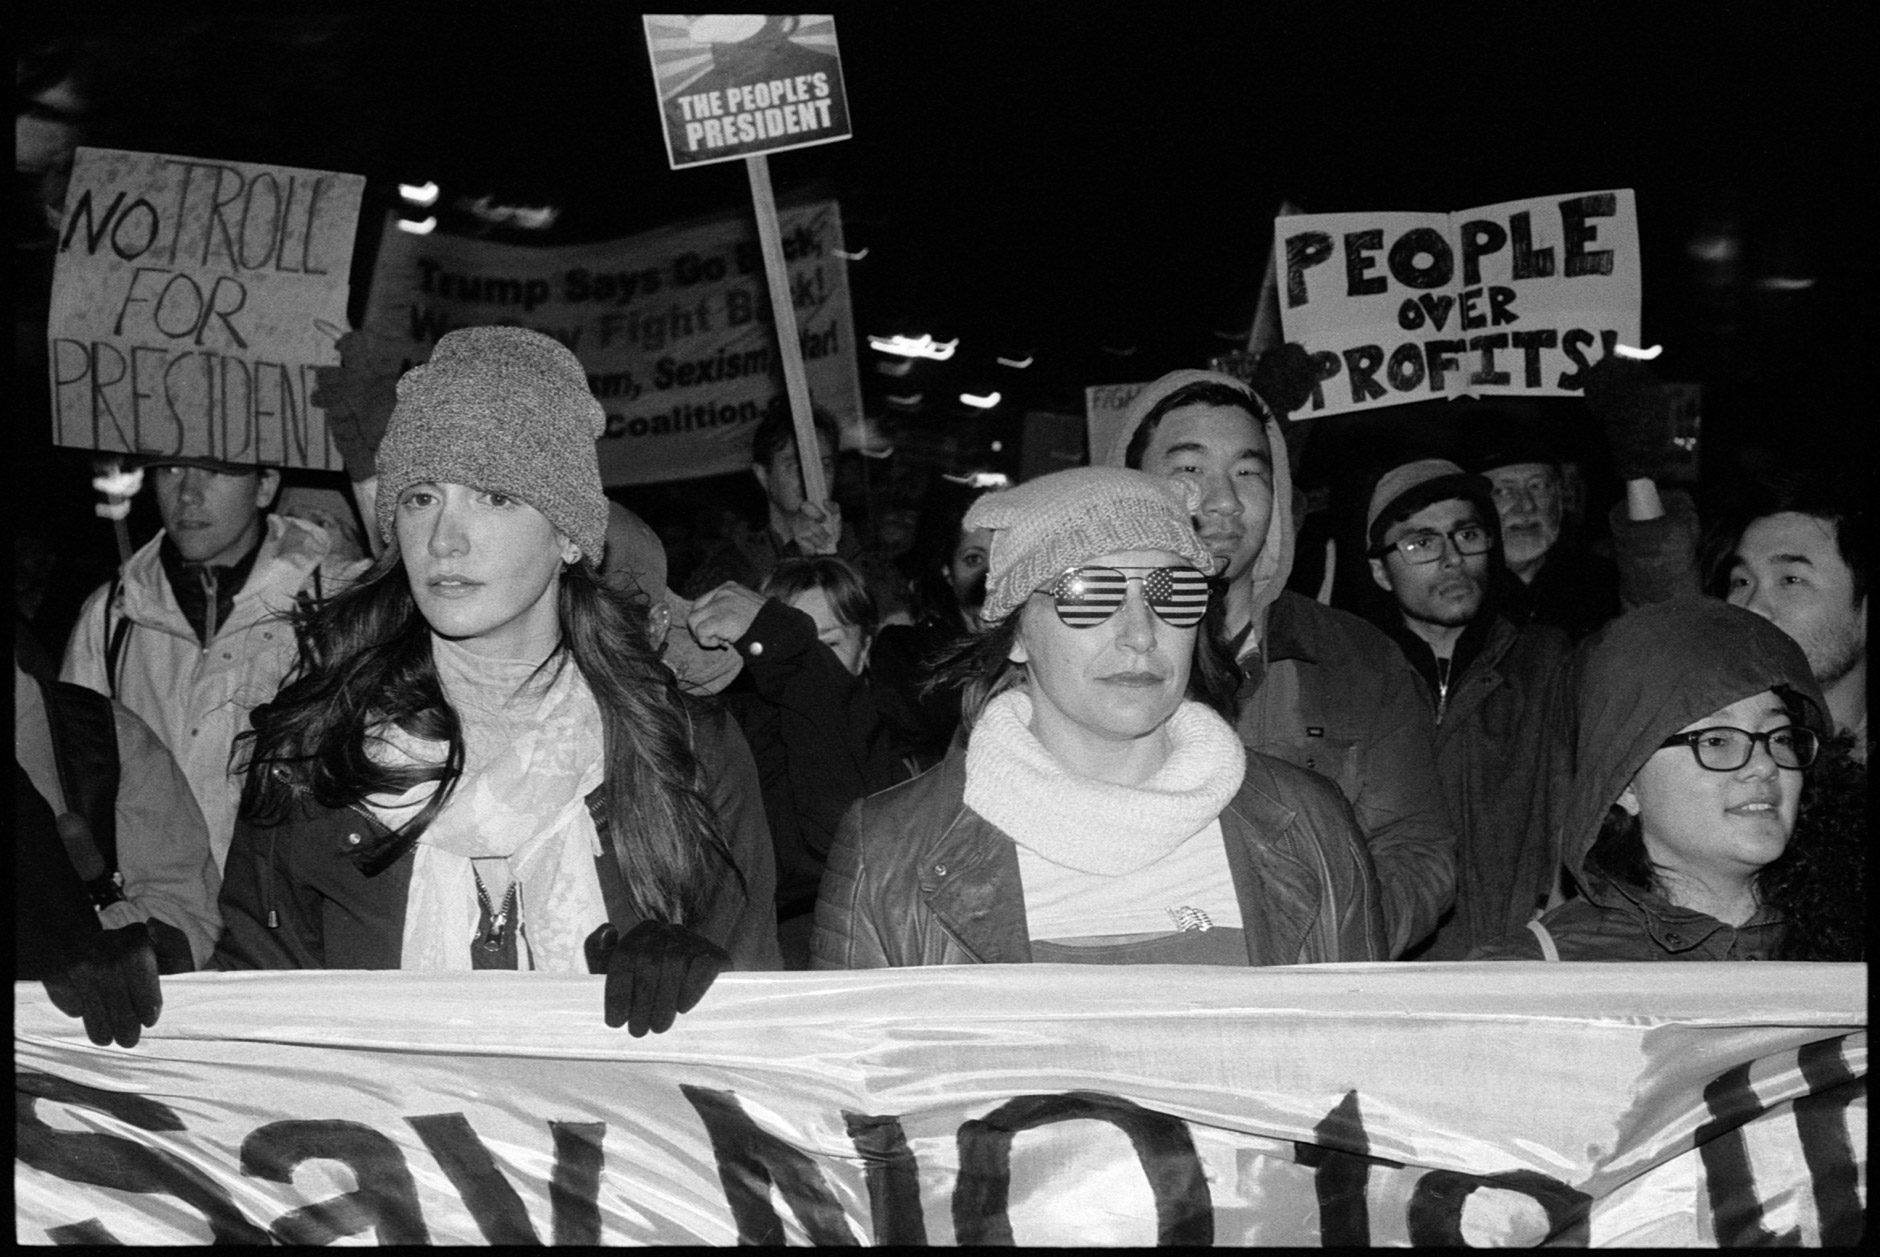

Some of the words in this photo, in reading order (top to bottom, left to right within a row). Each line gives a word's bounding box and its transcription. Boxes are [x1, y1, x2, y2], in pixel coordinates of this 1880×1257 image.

[677, 90, 724, 121] THE
[726, 71, 830, 113] PEOPLE'S
[685, 98, 832, 151] PRESIDENT
[60, 188, 160, 261] NO
[165, 159, 328, 276] TROLL
[1285, 192, 1617, 309] PEOPLE
[113, 266, 248, 349] FOR
[416, 252, 550, 311] Trump
[563, 265, 660, 306] Says
[674, 251, 726, 286] Go
[1397, 286, 1520, 331] OVER
[600, 298, 710, 351] Fight
